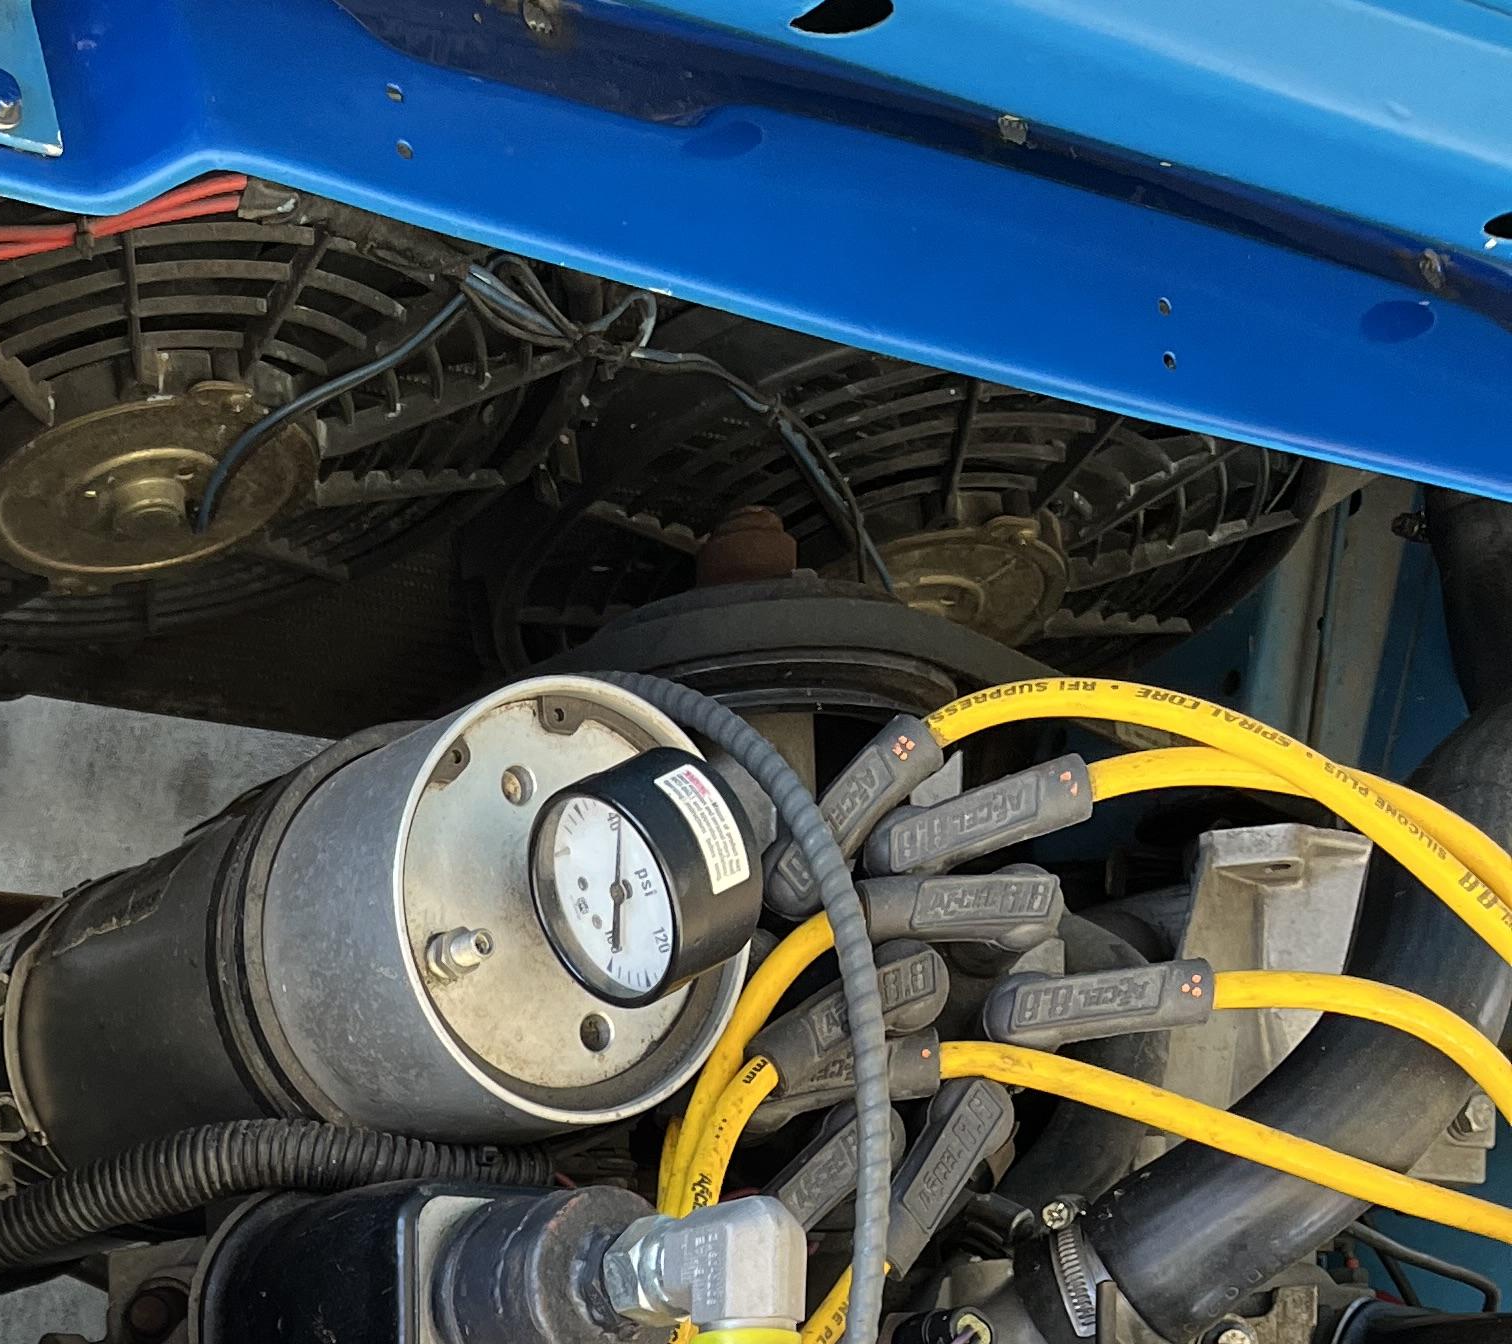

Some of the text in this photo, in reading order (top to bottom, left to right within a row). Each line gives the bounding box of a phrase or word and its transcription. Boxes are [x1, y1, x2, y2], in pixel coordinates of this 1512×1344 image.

[1059, 680, 1097, 692] RFI
[1136, 687, 1201, 710] CORE
[1208, 704, 1293, 748] SPIRAL
[1323, 762, 1369, 798] PLUS
[607, 812, 621, 831] 40
[1374, 798, 1448, 861] SILICONE
[634, 868, 658, 896] psi
[653, 926, 670, 953] 120
